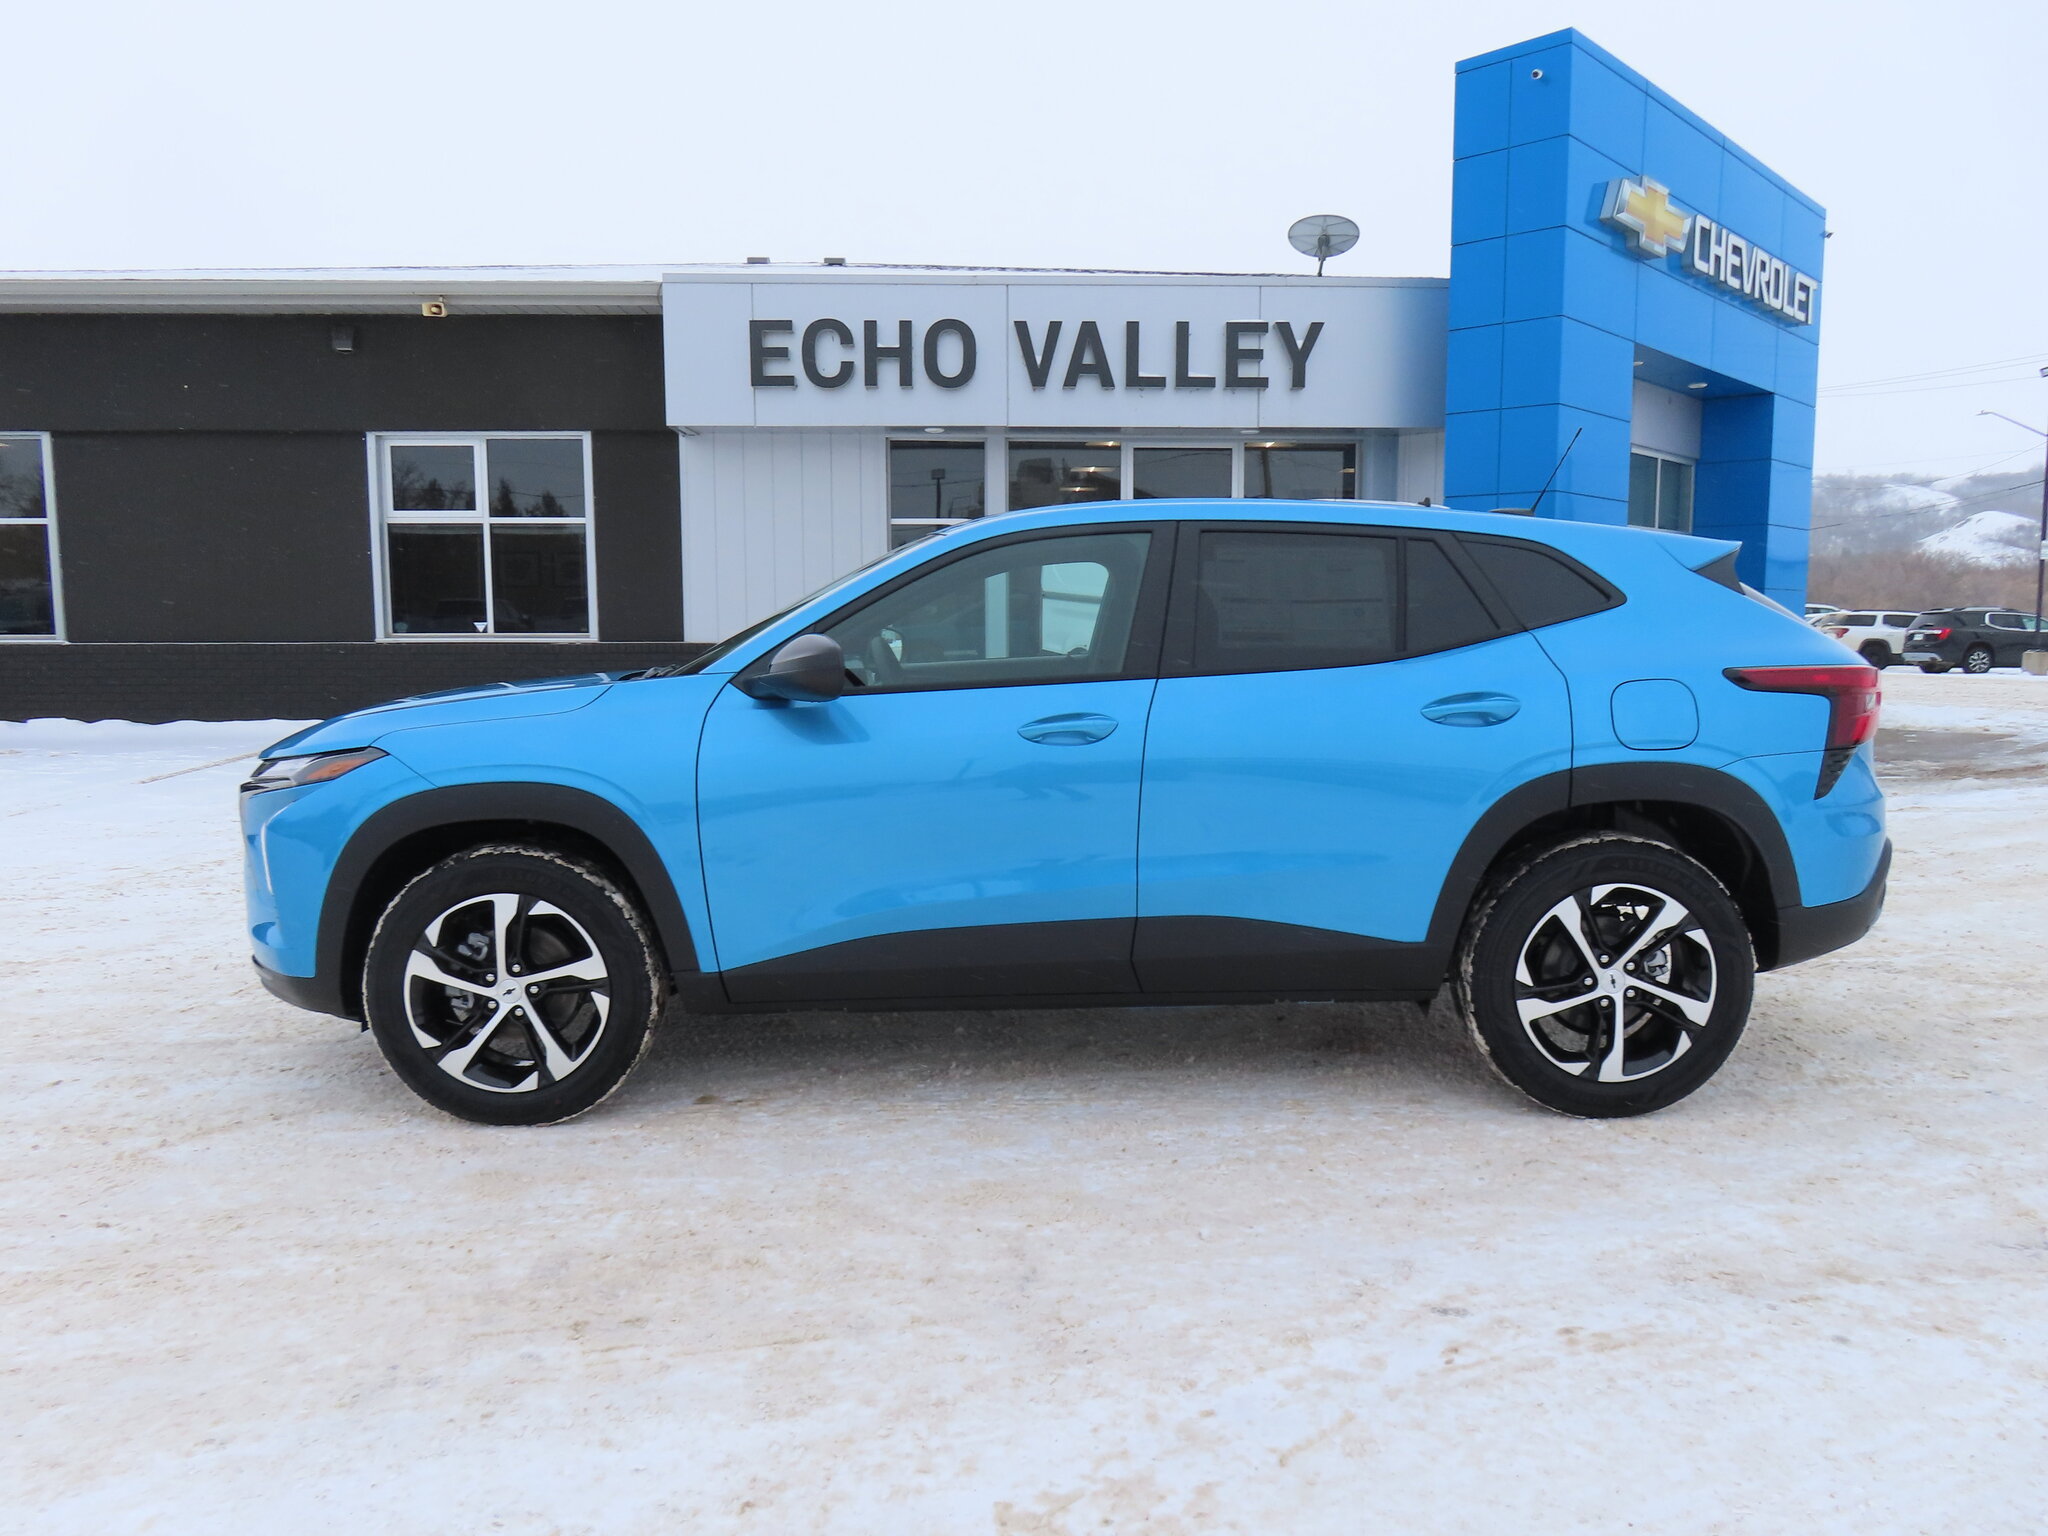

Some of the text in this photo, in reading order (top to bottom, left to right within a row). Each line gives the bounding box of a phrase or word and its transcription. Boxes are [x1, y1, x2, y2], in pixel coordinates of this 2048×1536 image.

[1693, 214, 1818, 325] CHEVROLET
[749, 319, 1325, 390] ECHO VALLEY
